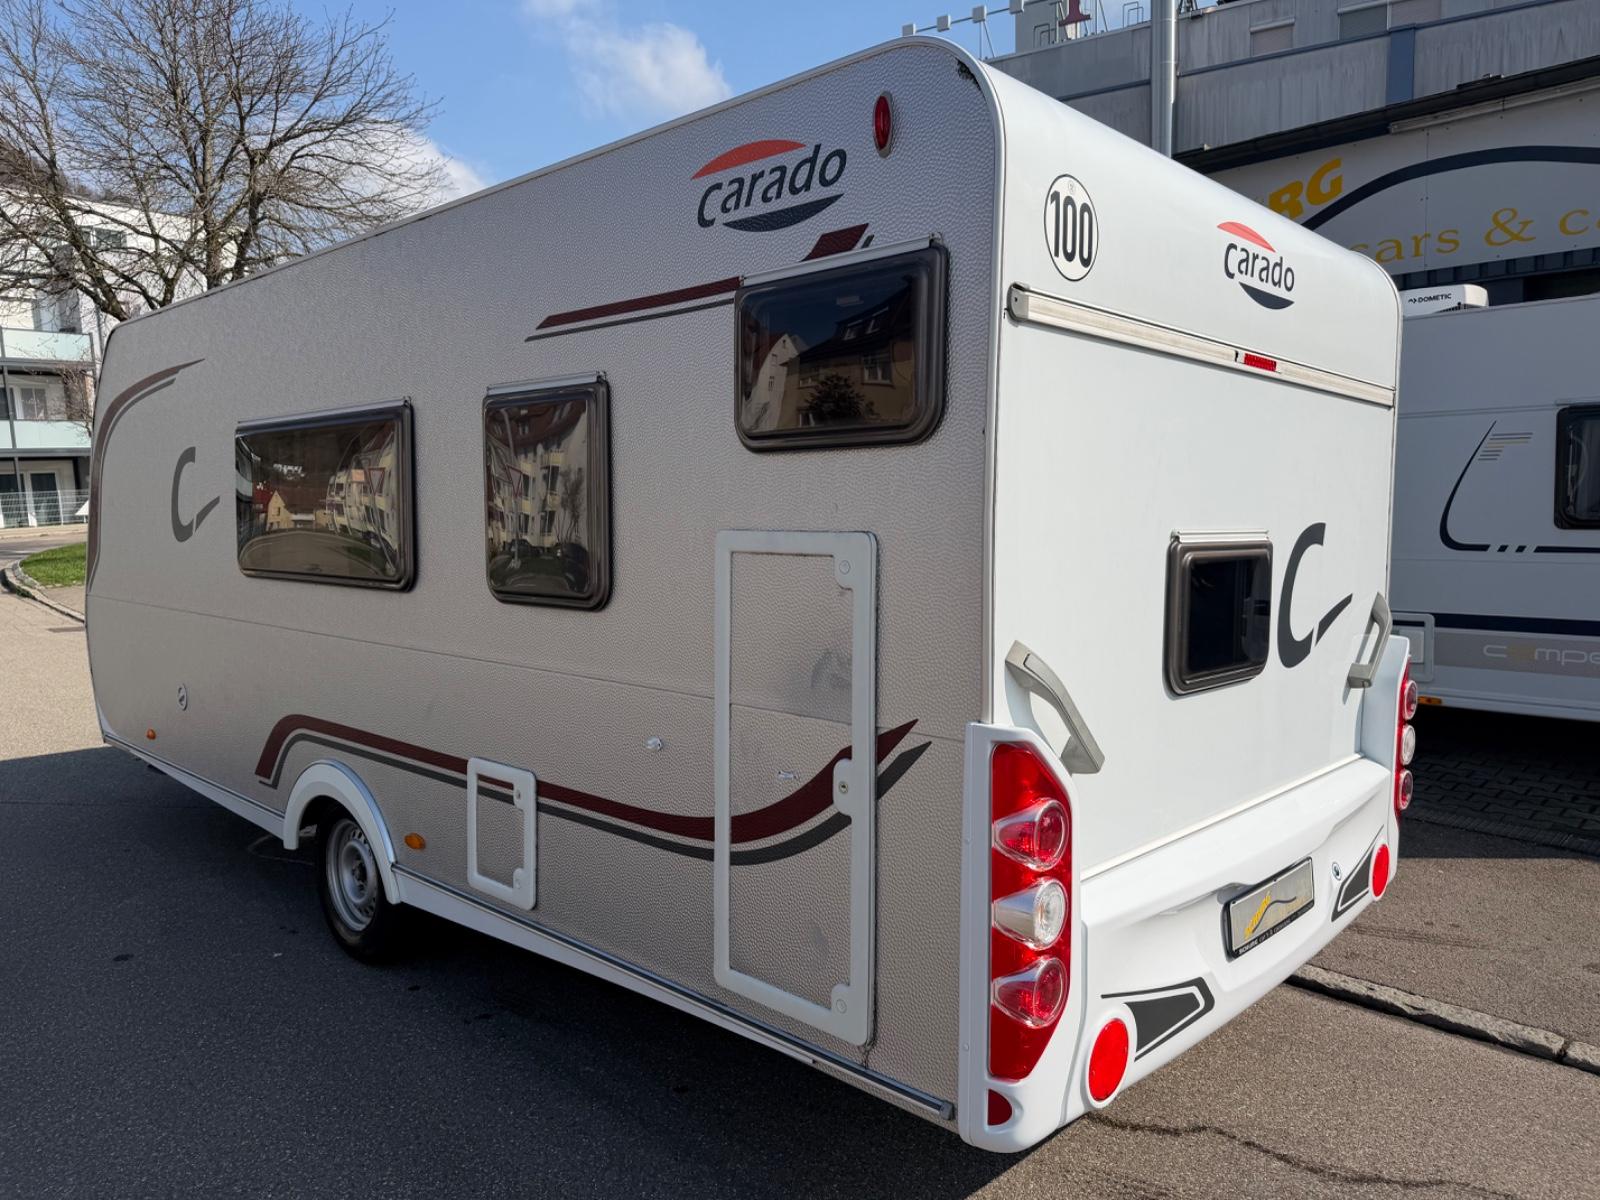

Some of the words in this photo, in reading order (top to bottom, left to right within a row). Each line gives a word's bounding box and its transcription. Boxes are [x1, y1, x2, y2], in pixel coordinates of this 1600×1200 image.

[697, 143, 847, 228] carado
[1050, 190, 1093, 268] 100
[1350, 229, 1460, 264] ars
[1484, 207, 1536, 247] &
[1558, 208, 1600, 236] c
[1224, 242, 1295, 292] carado
[1418, 292, 1452, 303] DOMETIC
